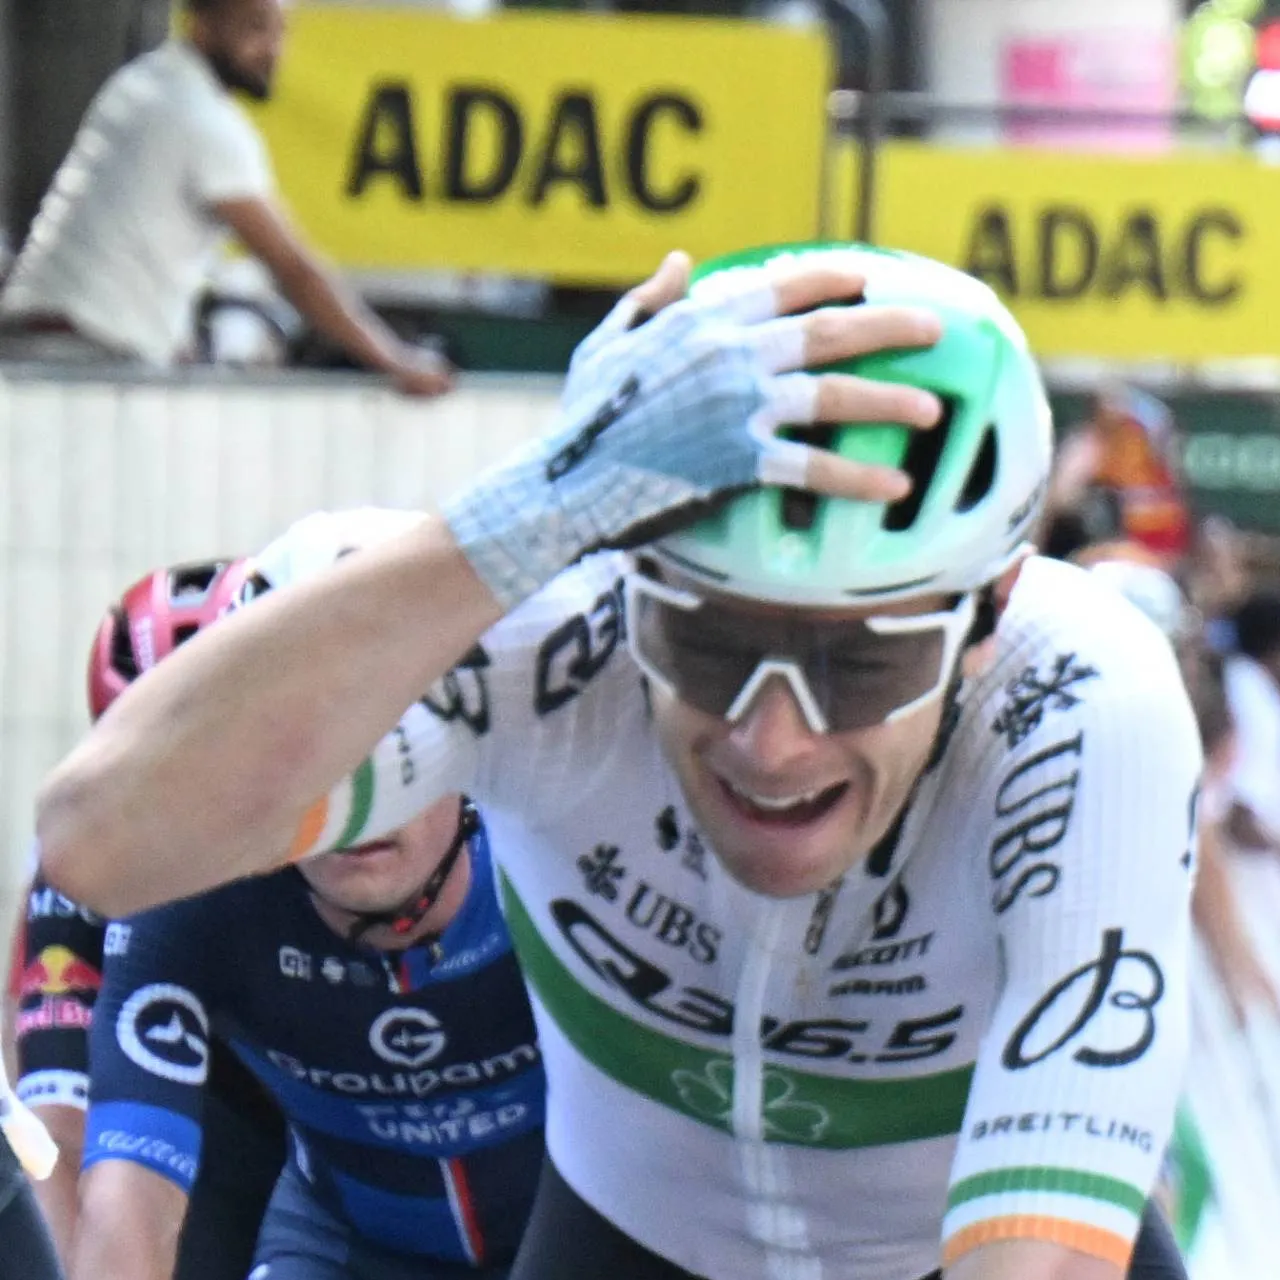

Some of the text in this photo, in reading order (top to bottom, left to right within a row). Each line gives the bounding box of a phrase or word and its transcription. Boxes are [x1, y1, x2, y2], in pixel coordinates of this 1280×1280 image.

[345, 80, 704, 214] ADAC
[960, 204, 1246, 308] ADAC
[990, 728, 1083, 914] UBS
[626, 880, 722, 966] UBS
[829, 931, 935, 971] SCOTT
[266, 1044, 538, 1097] Groupam
[970, 1110, 1155, 1153] BREITLING
